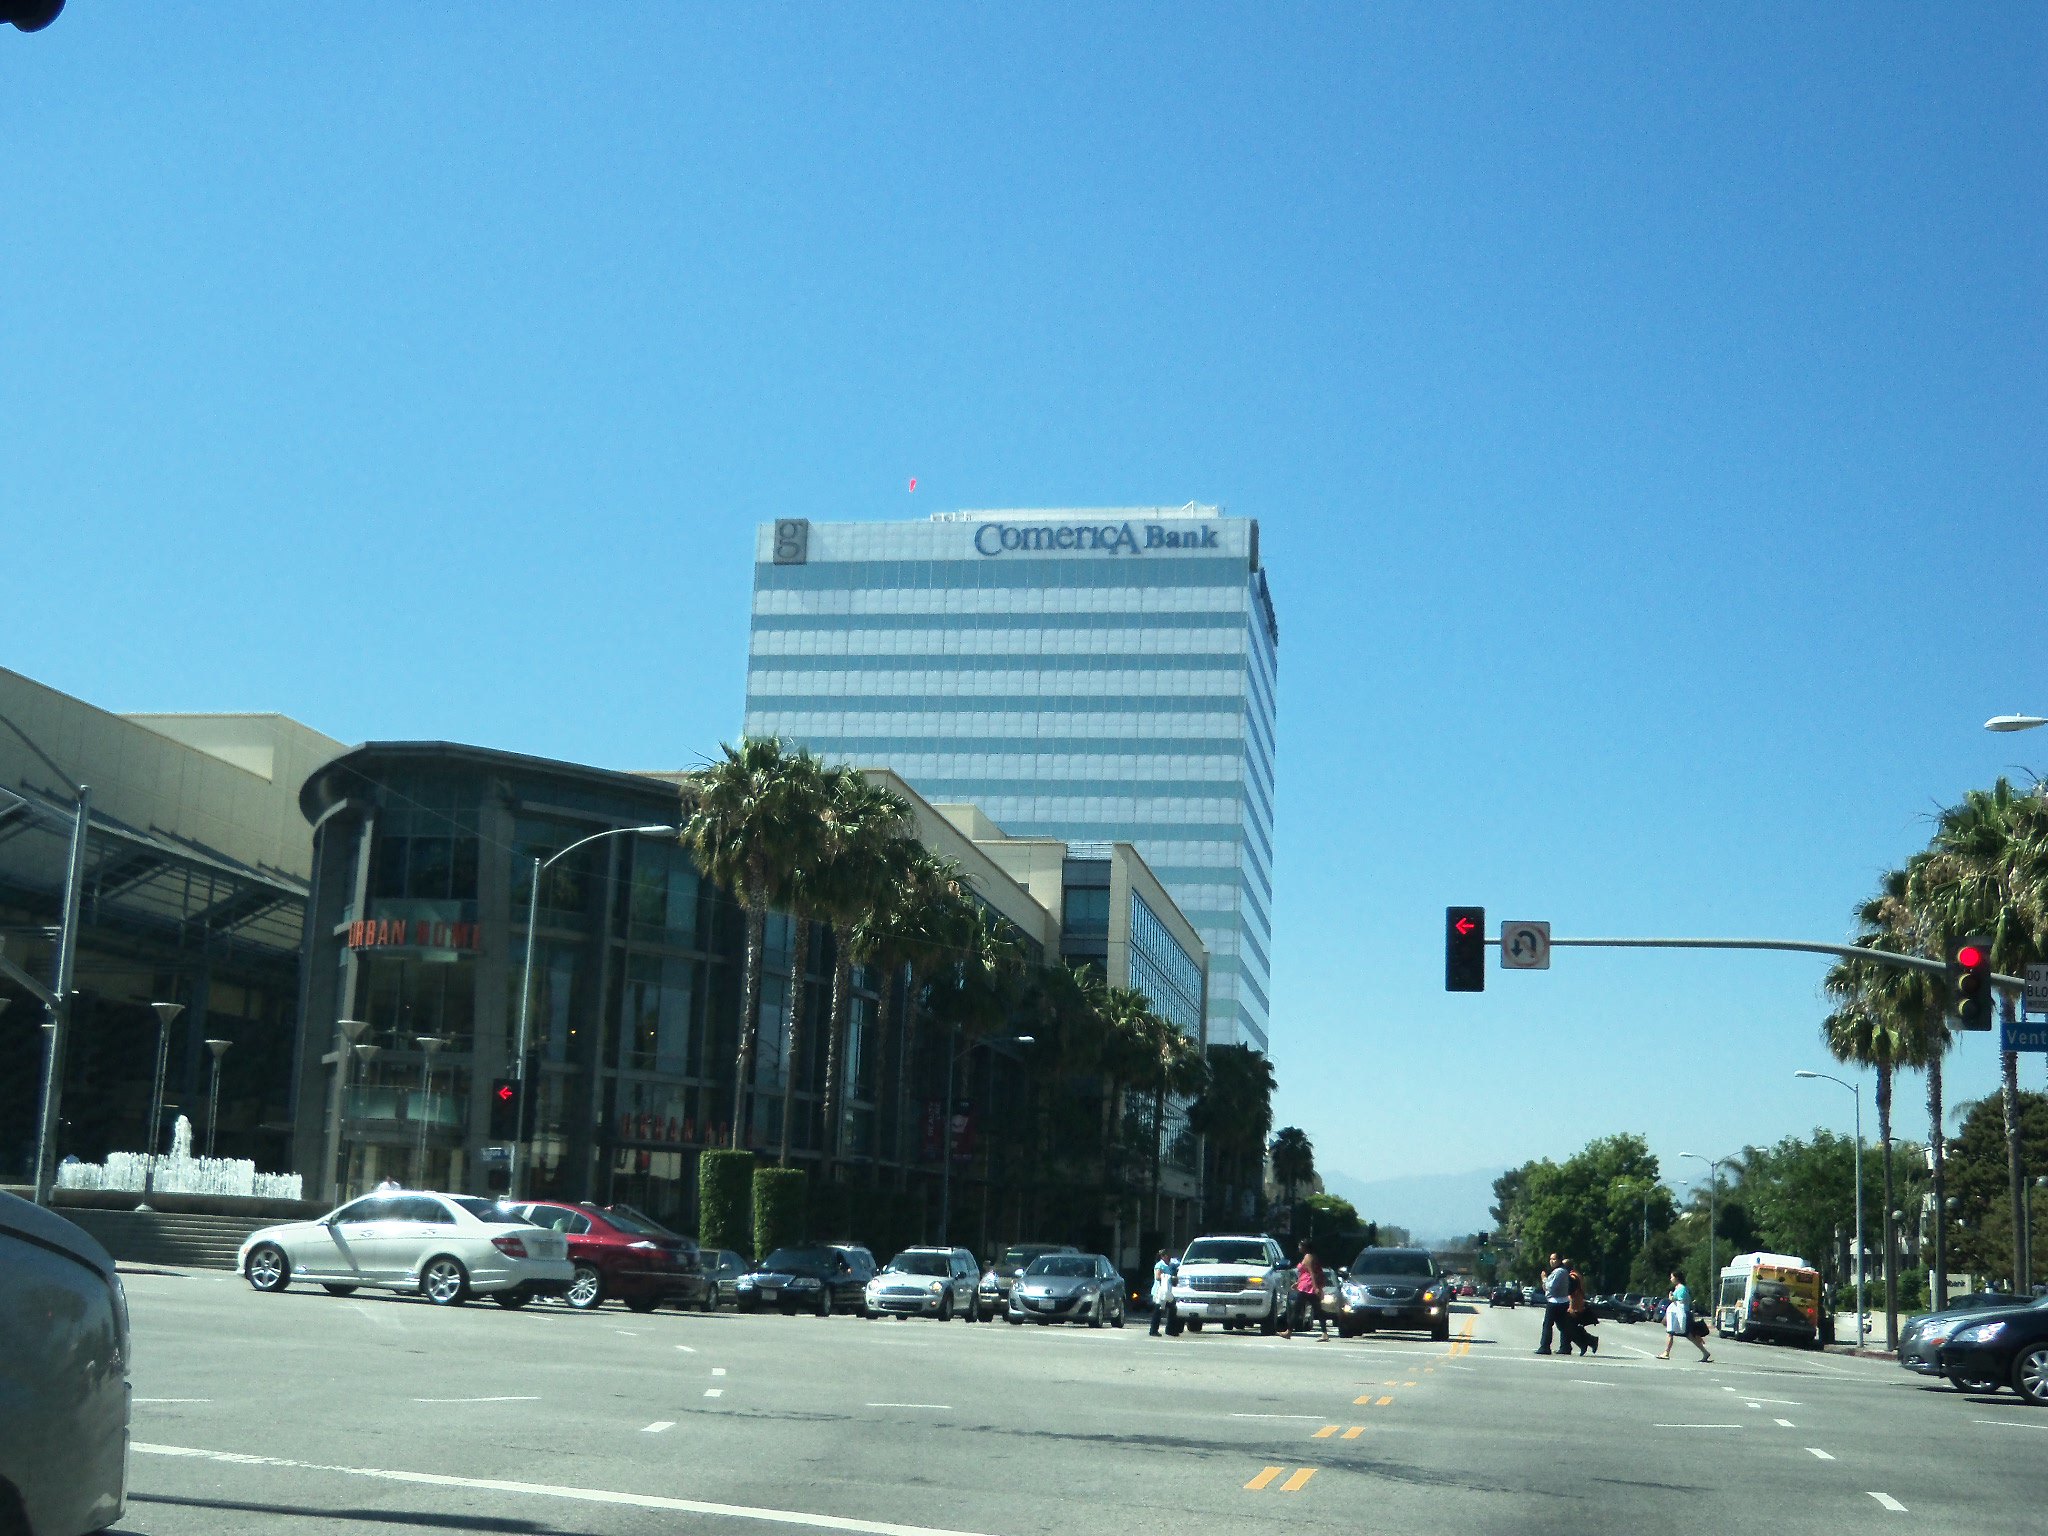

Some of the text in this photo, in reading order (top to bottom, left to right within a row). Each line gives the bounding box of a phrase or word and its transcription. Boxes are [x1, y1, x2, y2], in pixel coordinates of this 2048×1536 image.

[1144, 525, 1219, 549] Bank
[348, 919, 407, 948] URBAN
[2027, 970, 2040, 982] DO
